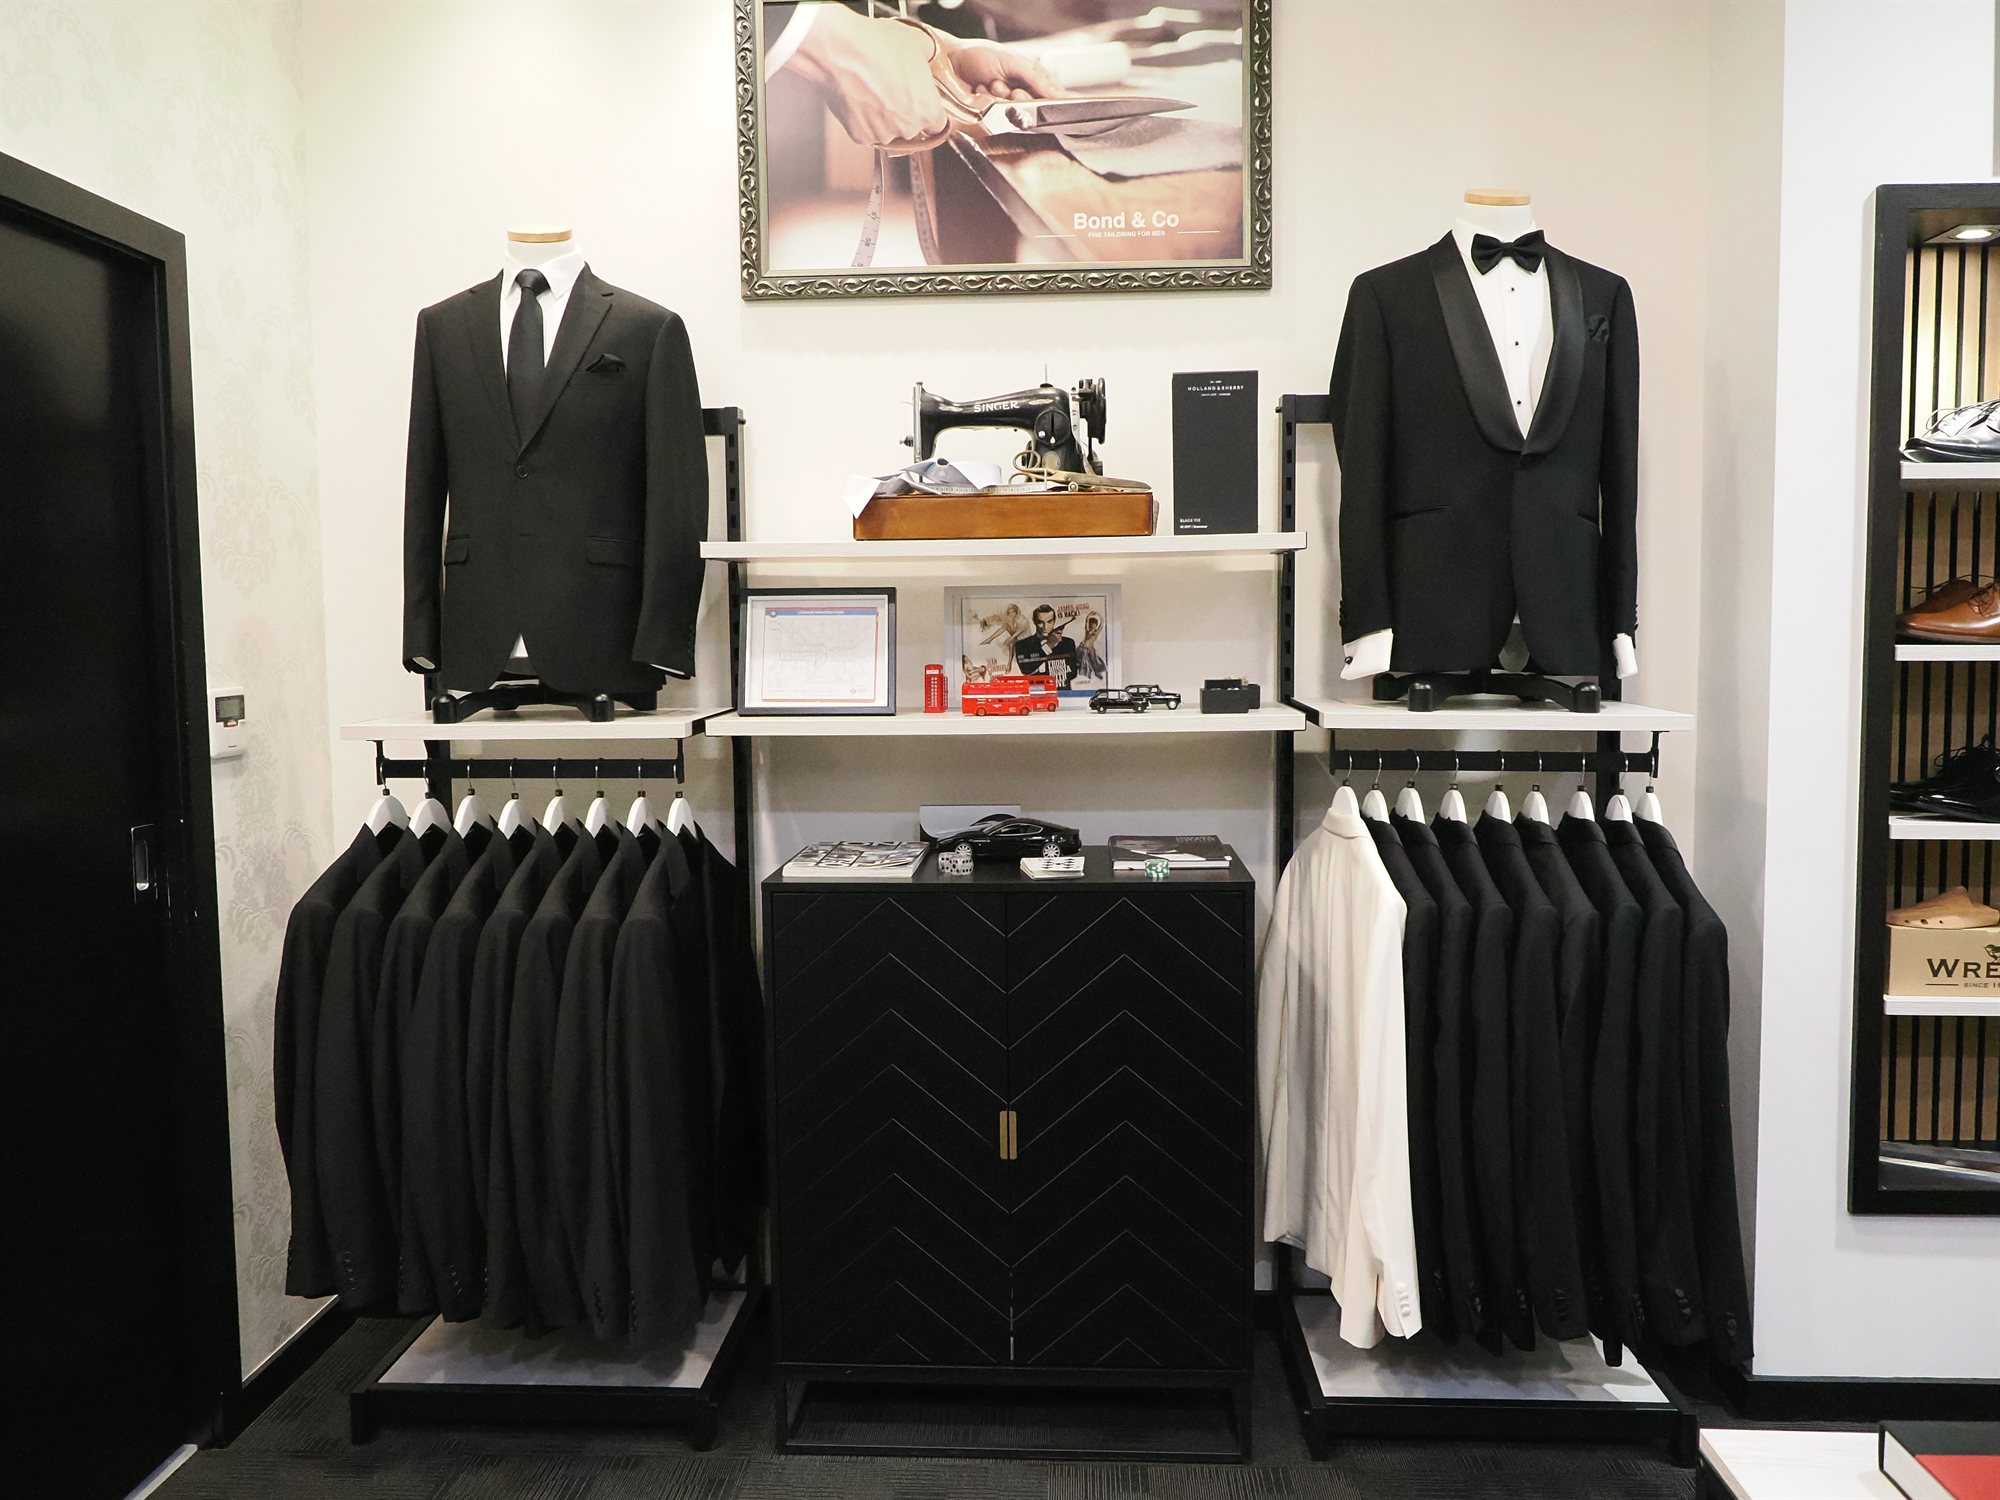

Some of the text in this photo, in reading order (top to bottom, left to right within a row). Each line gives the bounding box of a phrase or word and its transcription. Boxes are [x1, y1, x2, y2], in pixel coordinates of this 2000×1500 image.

[1073, 210, 1180, 230] Bond & Co
[973, 401, 1020, 413] SINGER
